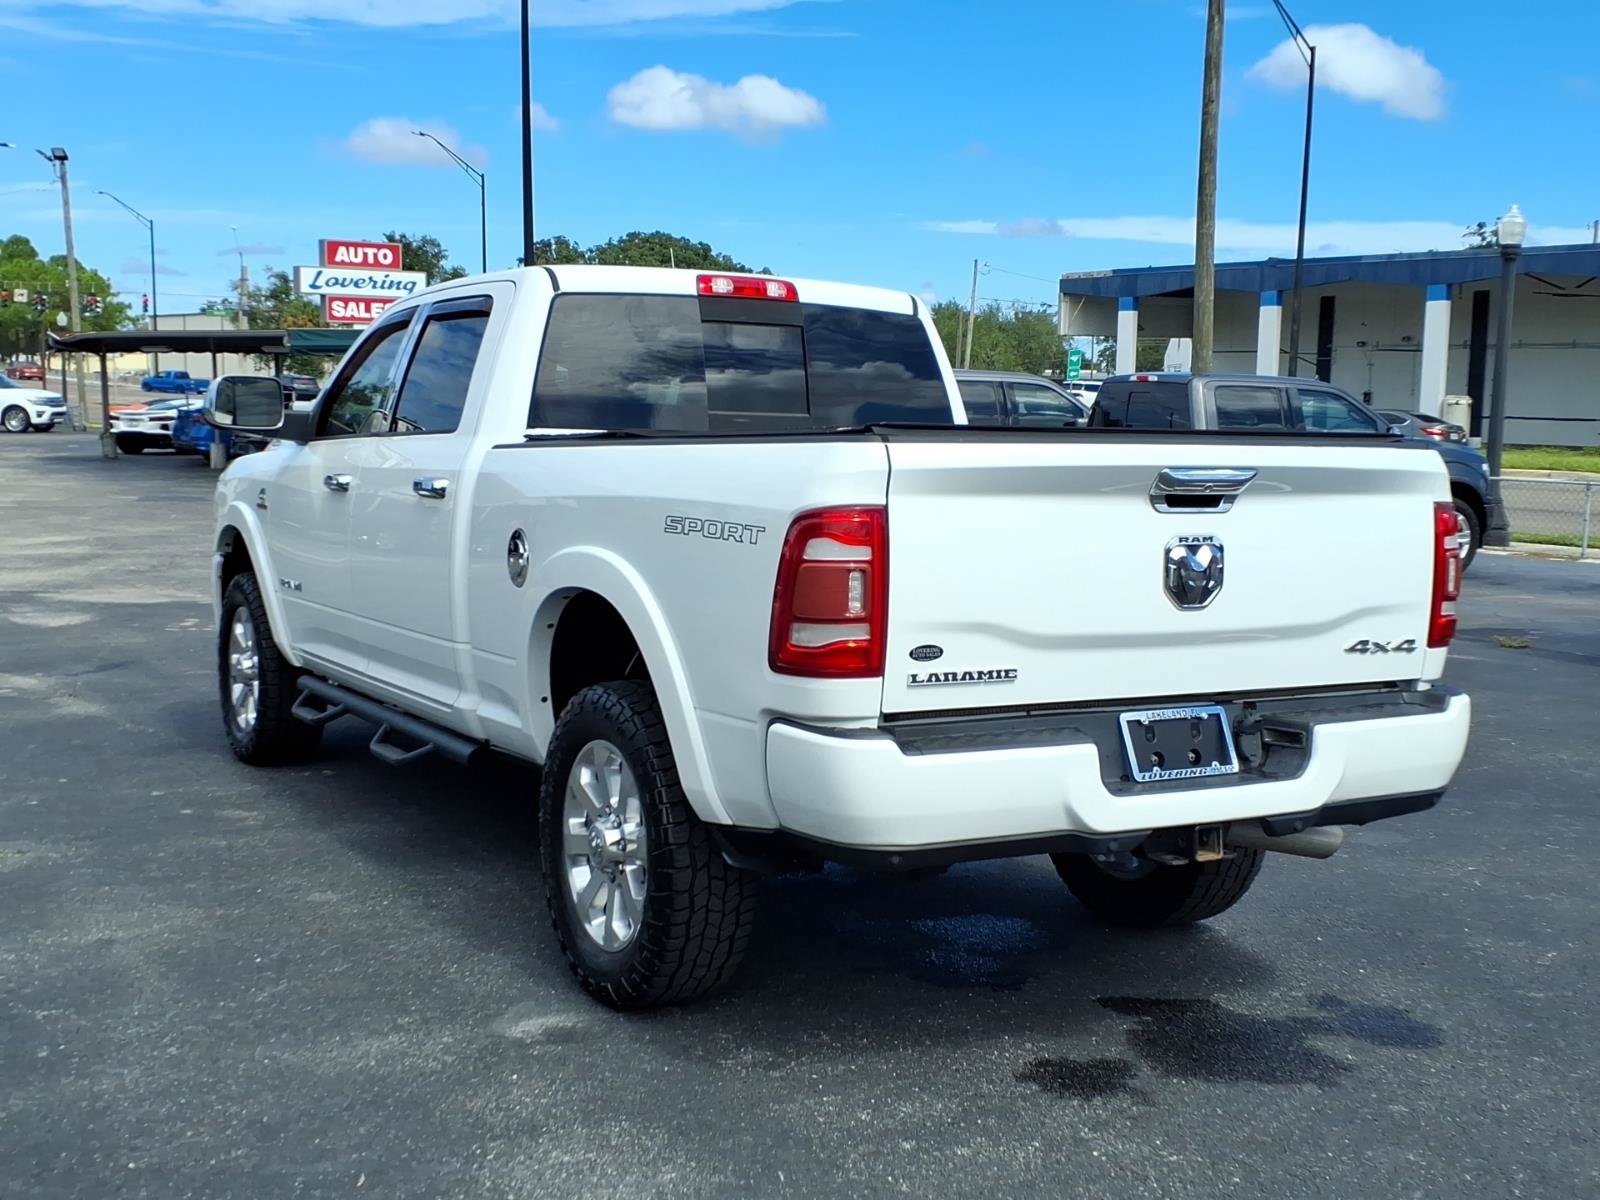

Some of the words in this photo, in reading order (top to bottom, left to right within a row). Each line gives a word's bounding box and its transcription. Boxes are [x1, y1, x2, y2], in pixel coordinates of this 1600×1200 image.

[334, 245, 394, 265] AUTO
[308, 270, 417, 295] Lovering
[664, 515, 766, 545] SPORT
[910, 669, 1018, 684] LARAMIE
[1141, 768, 1207, 780] LOVERING
